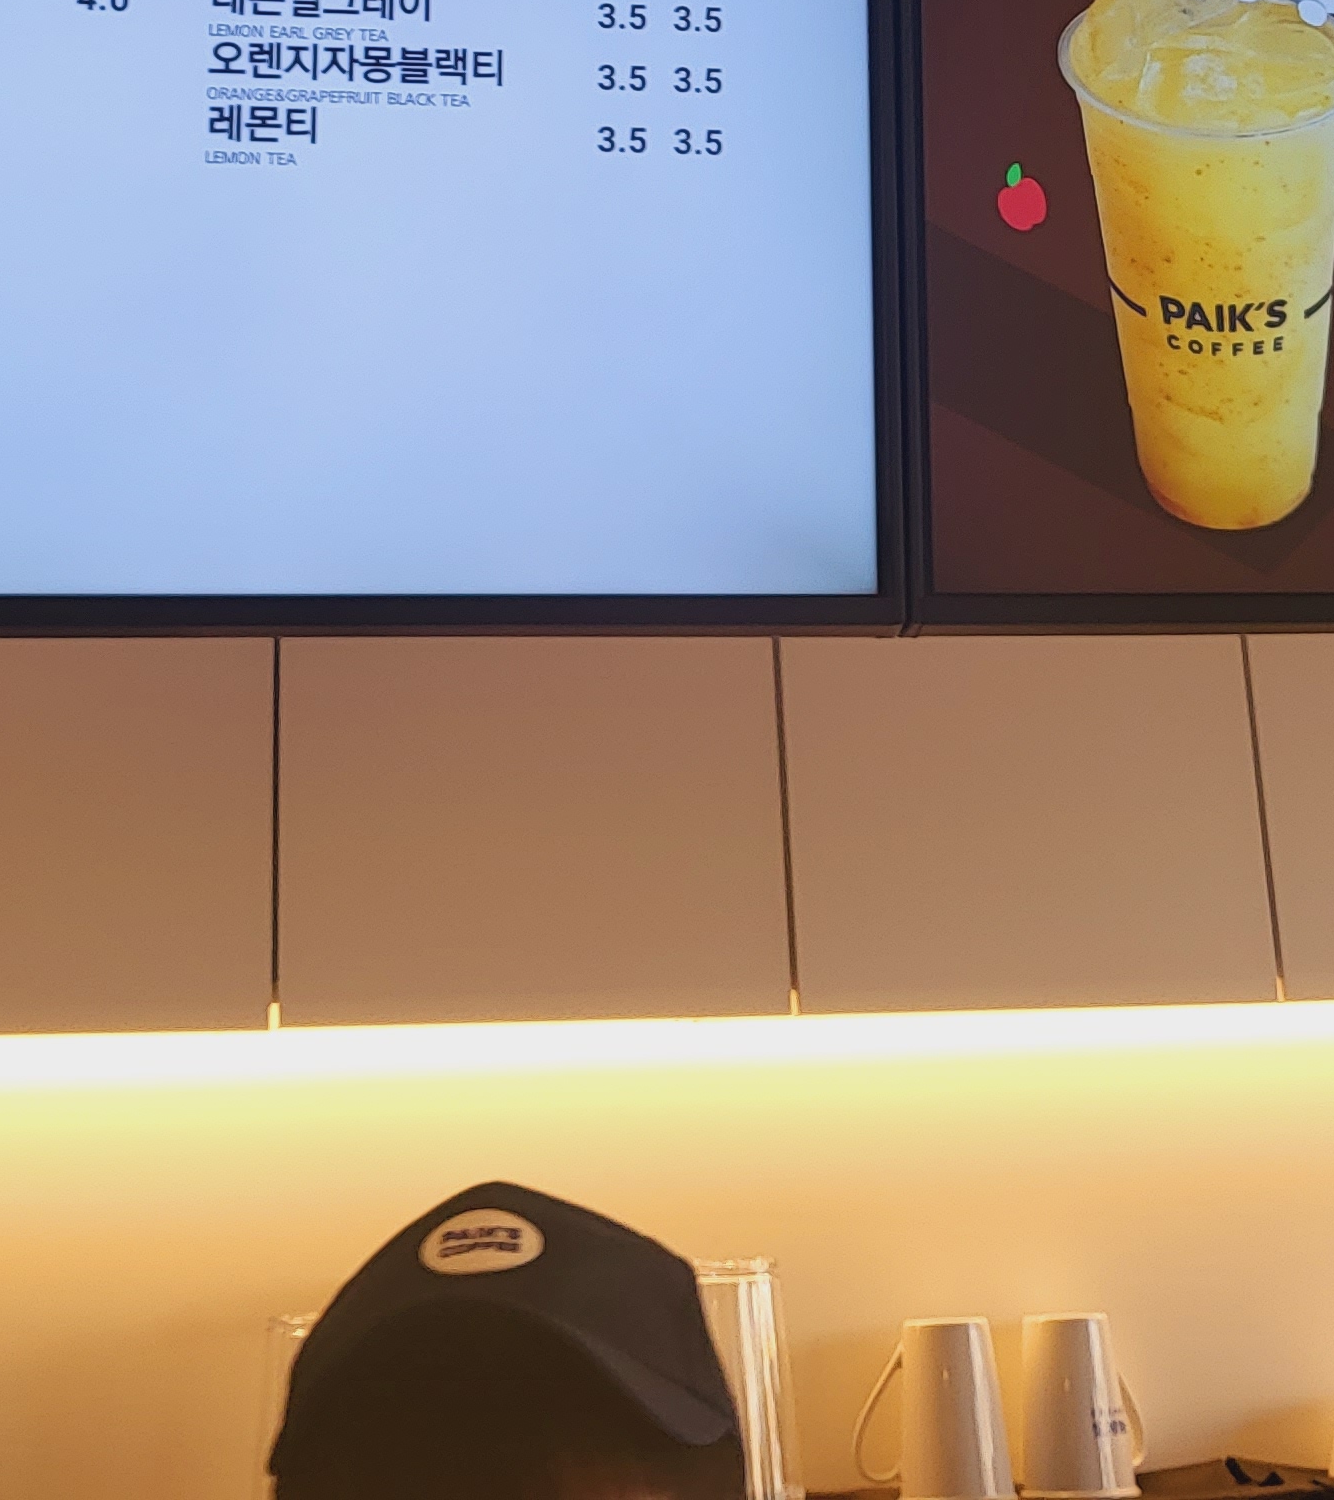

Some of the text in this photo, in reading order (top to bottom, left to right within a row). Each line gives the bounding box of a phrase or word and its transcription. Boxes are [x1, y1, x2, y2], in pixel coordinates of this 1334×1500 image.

[208, 42, 504, 86] 오렌지자몽블랙티
[208, 105, 318, 144] 레몬티
[1159, 295, 1287, 332] PAIK'S
[1167, 334, 1284, 356] COFFEE
